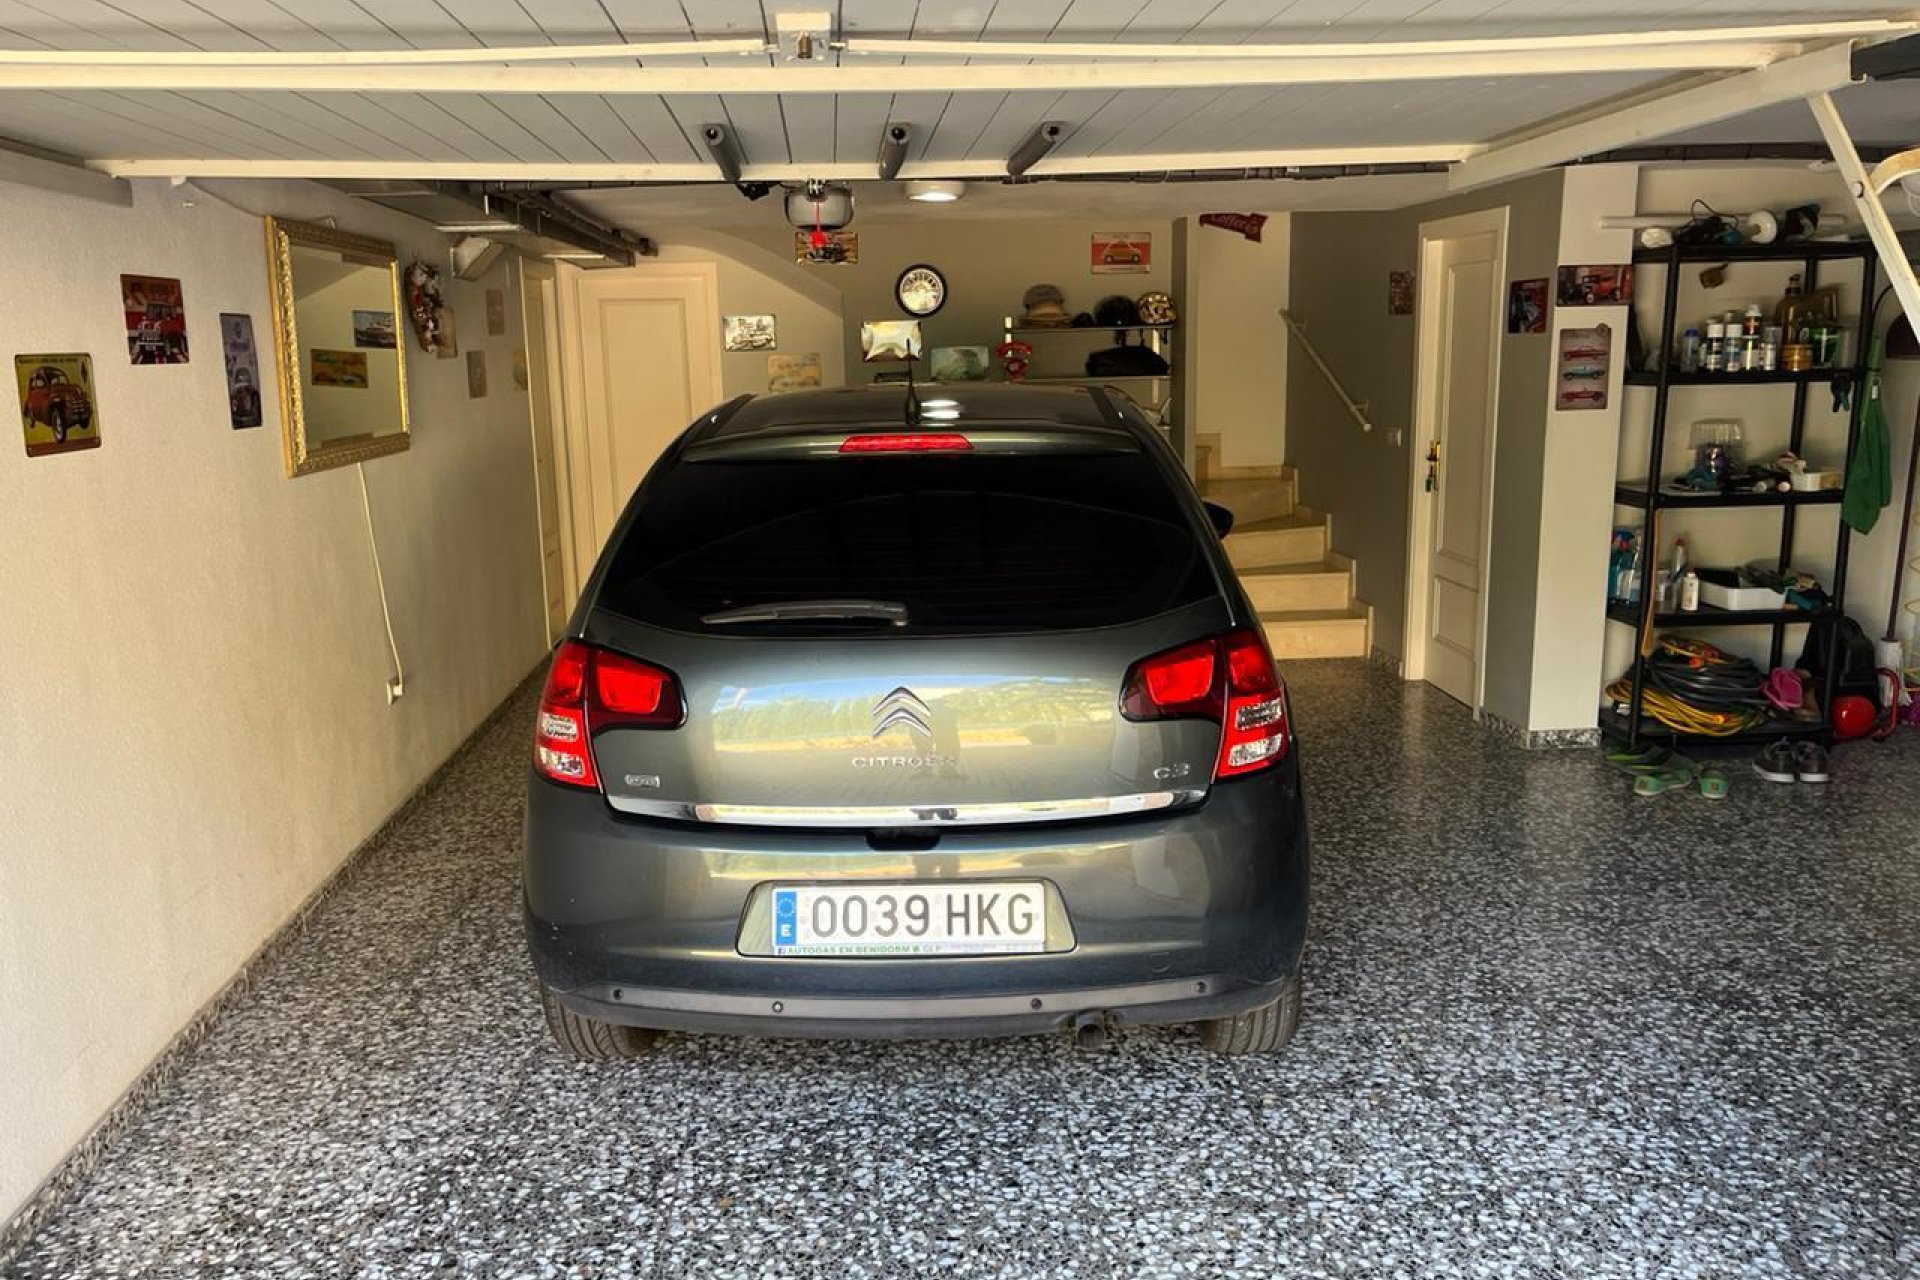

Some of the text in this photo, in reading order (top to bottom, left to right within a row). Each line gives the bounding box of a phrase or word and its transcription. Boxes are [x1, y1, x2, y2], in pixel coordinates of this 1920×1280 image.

[812, 893, 1033, 938] 0039 HKG
[781, 925, 791, 938] E
[788, 946, 834, 955] AUTOGAS
[839, 946, 853, 954] EN
[856, 945, 910, 953] BENIDORM
